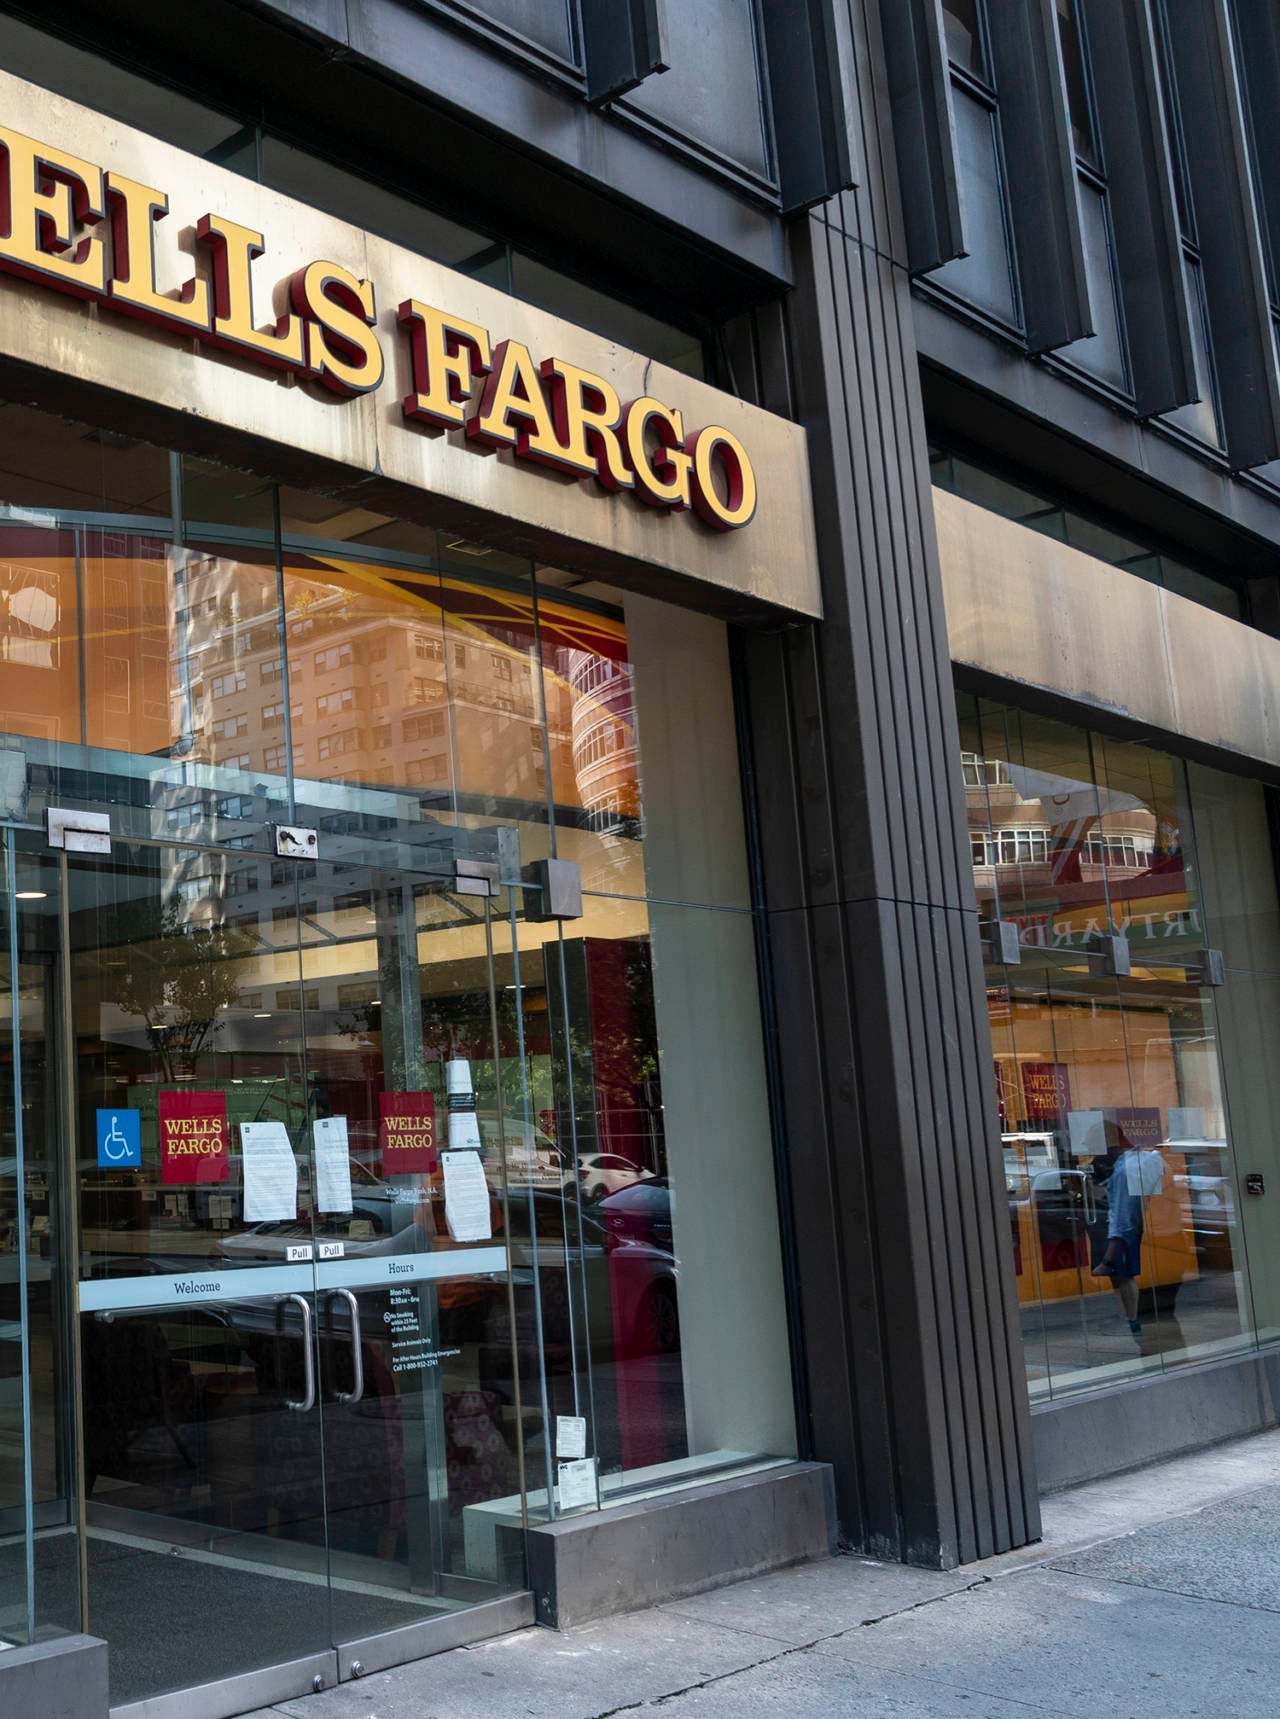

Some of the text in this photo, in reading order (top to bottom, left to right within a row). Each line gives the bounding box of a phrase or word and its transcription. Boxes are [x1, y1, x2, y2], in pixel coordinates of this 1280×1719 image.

[398, 298, 758, 530] FARGO
[1029, 1074, 1065, 1090] WELLS
[164, 1119, 222, 1135] WELLS
[384, 1116, 432, 1132] WELLS
[167, 1138, 223, 1155] FARGO
[387, 1133, 433, 1149] FARGO
[292, 1248, 308, 1259] Pull
[324, 1245, 340, 1256] Pull
[388, 1263, 414, 1274] Hours
[174, 1280, 221, 1294] Welcome
[392, 1364, 403, 1372] Call
